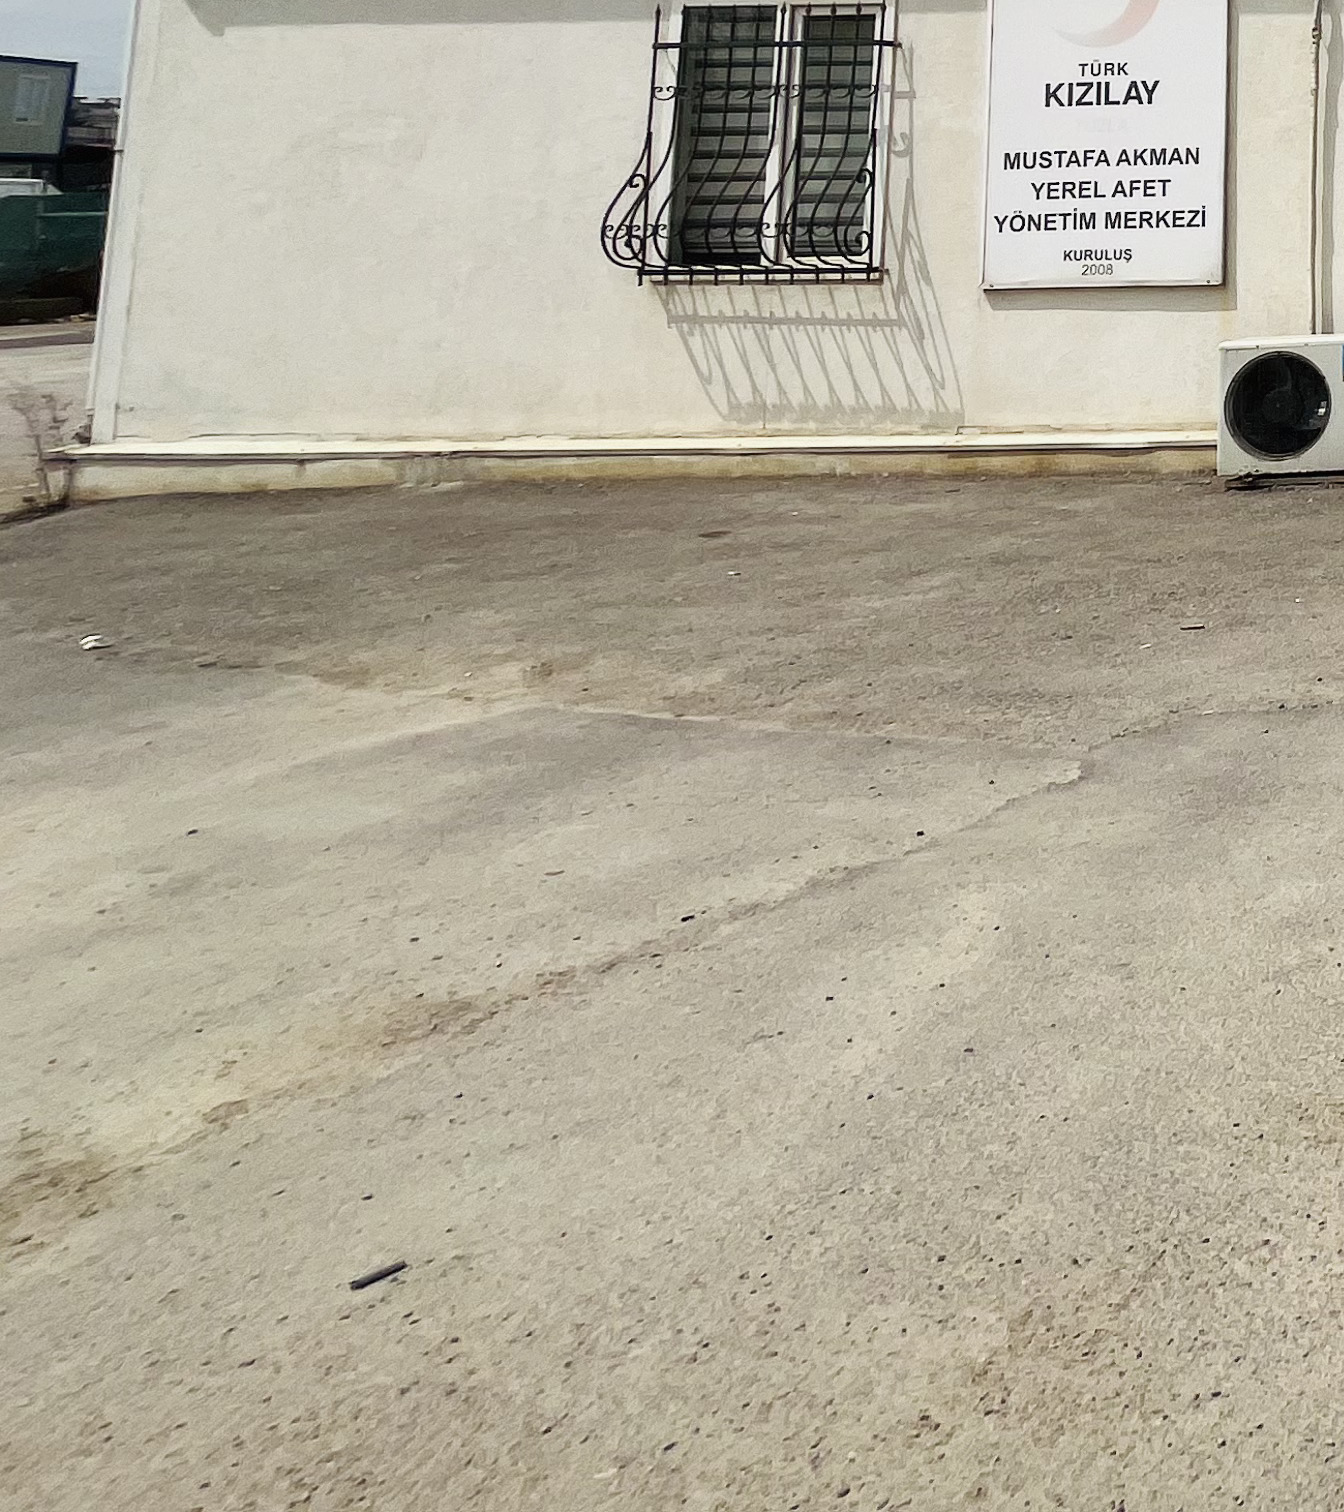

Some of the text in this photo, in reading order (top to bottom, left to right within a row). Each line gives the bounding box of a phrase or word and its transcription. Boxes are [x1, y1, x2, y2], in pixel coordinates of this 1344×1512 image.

[1078, 59, 1129, 77] TÜRK
[1045, 80, 1160, 107] KIZILAY
[1003, 147, 1200, 170] MUSTAFA AKMAN
[1031, 179, 1172, 200] YEREL AFET
[993, 205, 1206, 233] YÖNETİM MERKEZİ
[1063, 249, 1133, 263] KURULUŞ
[1081, 263, 1114, 276] 2008
